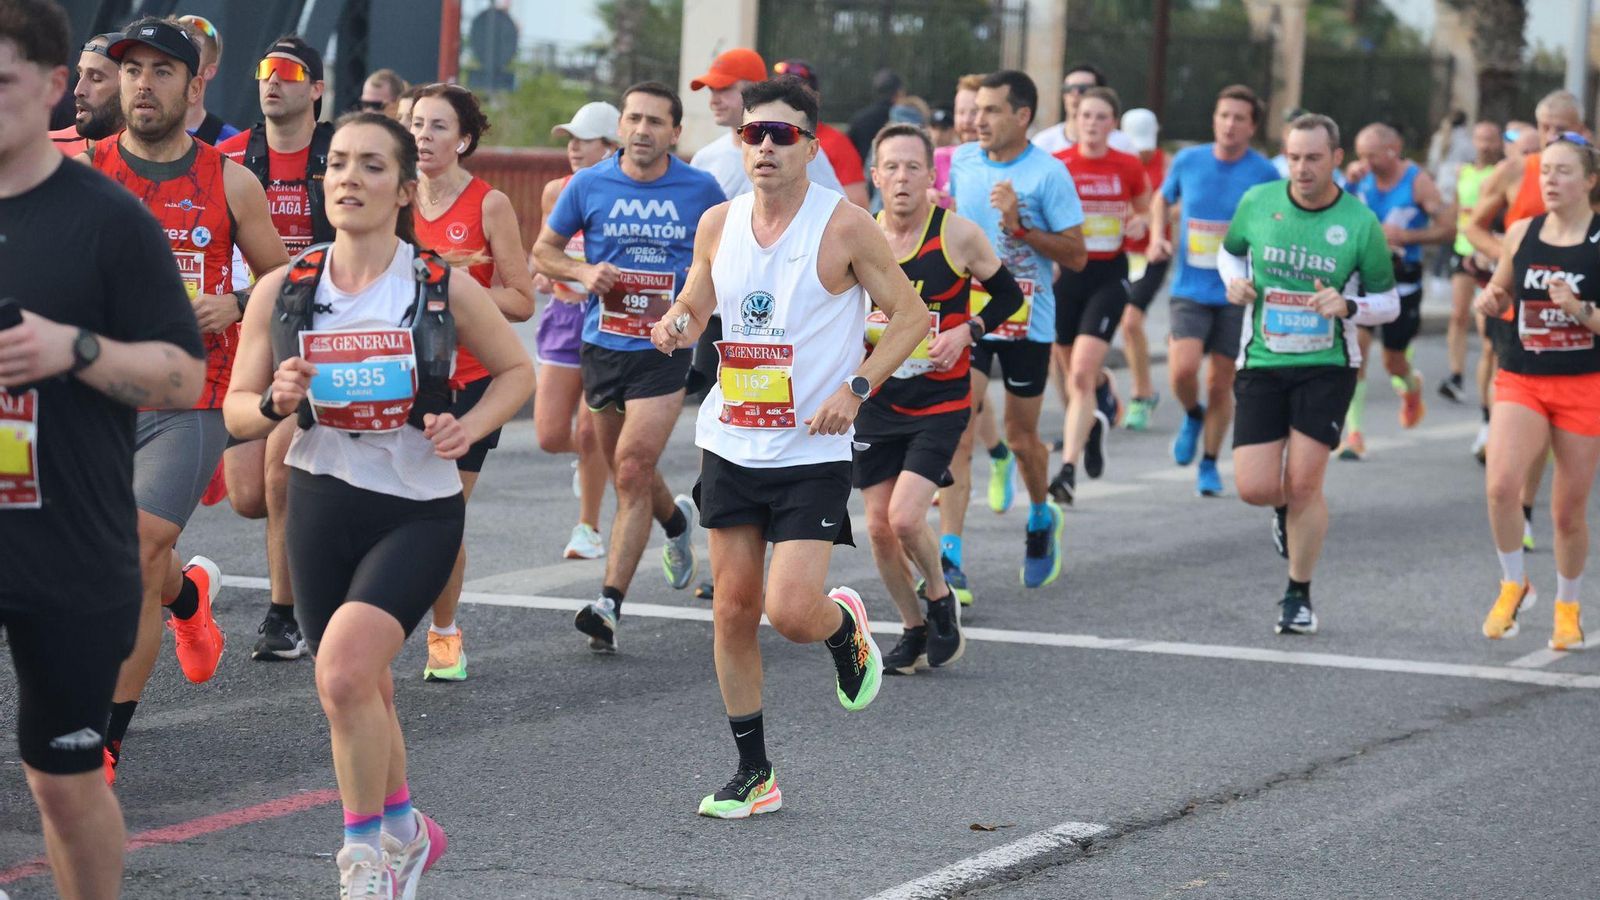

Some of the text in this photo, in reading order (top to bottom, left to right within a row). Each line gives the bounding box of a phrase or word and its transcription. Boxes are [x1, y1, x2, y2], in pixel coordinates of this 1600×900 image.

[602, 221, 687, 240] MARATÓN
[625, 246, 657, 256] VIDEO
[633, 254, 668, 264] FINISH
[1263, 244, 1337, 273] mijas
[620, 273, 670, 286] GENERALI
[622, 294, 649, 309] 498
[1277, 312, 1319, 328] 15208
[332, 334, 405, 351] GENERALI
[734, 345, 789, 360] GENERAL
[331, 367, 386, 388] 5935
[734, 373, 769, 390] 1162
